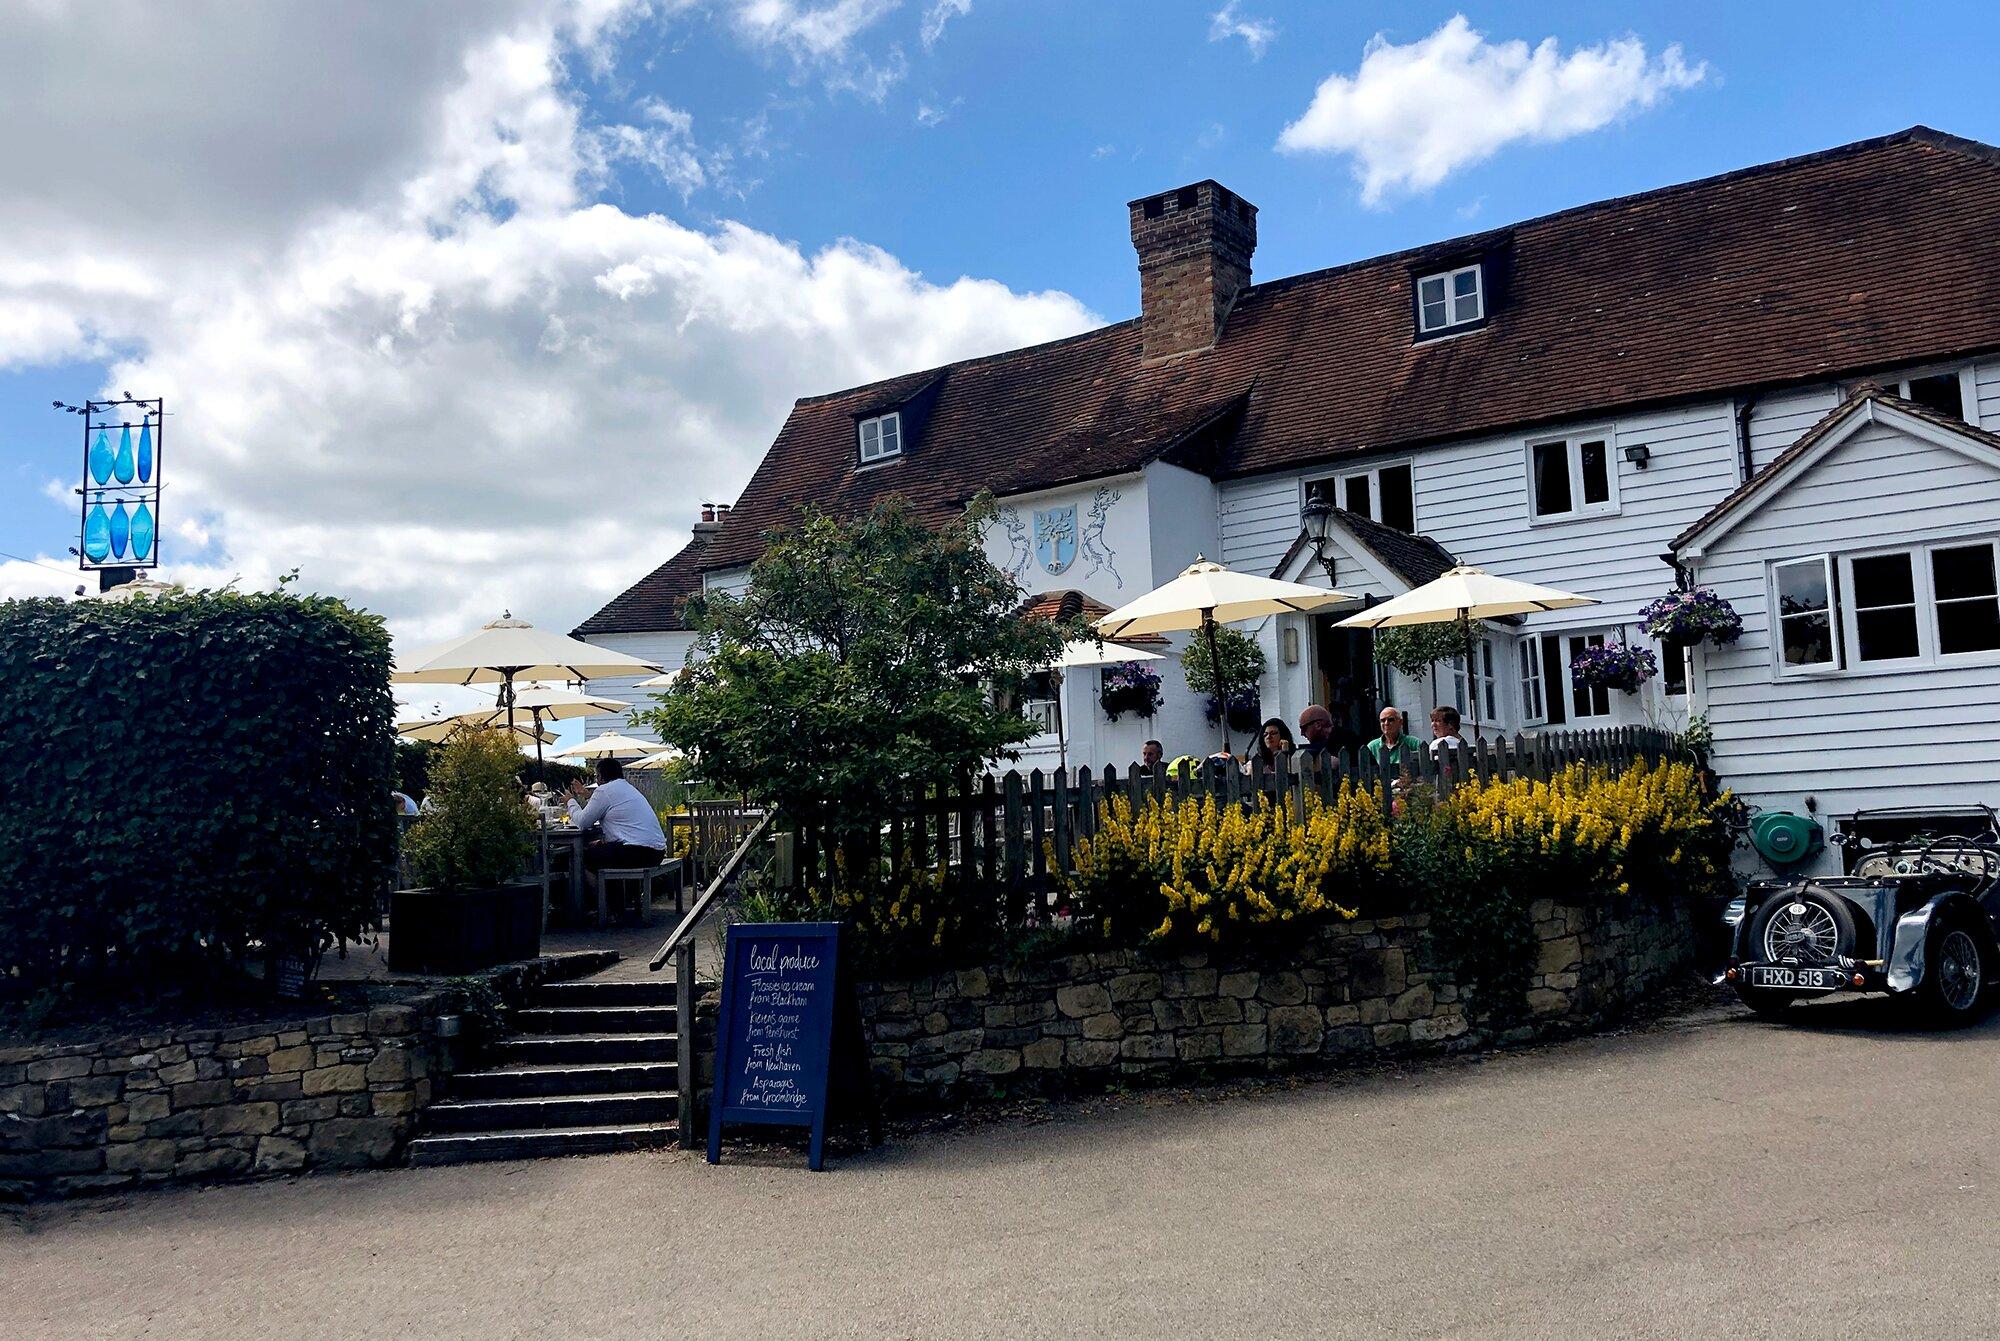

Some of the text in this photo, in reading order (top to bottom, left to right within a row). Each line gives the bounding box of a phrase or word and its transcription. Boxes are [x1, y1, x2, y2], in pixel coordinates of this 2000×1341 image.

[779, 944, 820, 977] produce
[791, 981, 815, 992] cream
[1763, 970, 1823, 986] HXD 513
[748, 991, 770, 1010] from
[778, 1014, 801, 1030] game
[746, 1024, 764, 1042] from
[752, 1043, 792, 1062] Fresh fish
[744, 1056, 801, 1075] from Newhaven
[752, 1075, 795, 1093] Asparagus
[740, 1088, 808, 1108] from Groombridge
